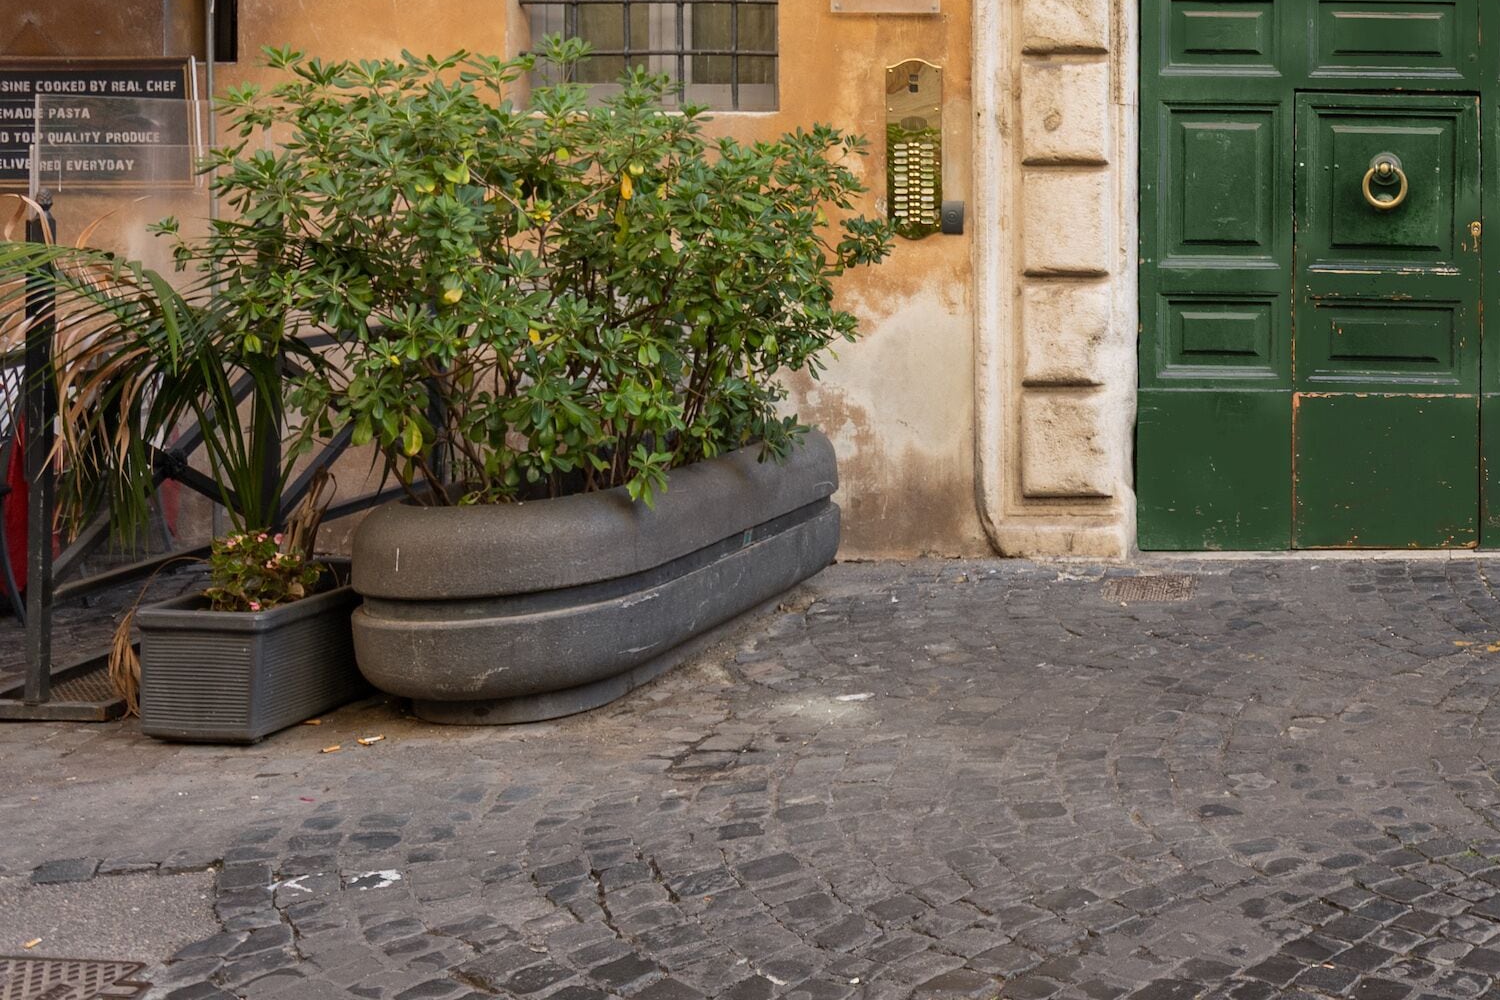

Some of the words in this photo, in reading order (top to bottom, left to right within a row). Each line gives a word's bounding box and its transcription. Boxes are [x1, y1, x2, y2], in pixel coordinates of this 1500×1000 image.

[35, 80, 86, 92] COOKED
[90, 81, 107, 92] BY
[111, 81, 143, 92] REAL
[146, 80, 177, 92] CHEF
[49, 108, 90, 119] PASTA
[48, 132, 101, 147] QUALITY
[106, 132, 160, 143] PRODUCE
[67, 159, 135, 171] EVERYDAY
